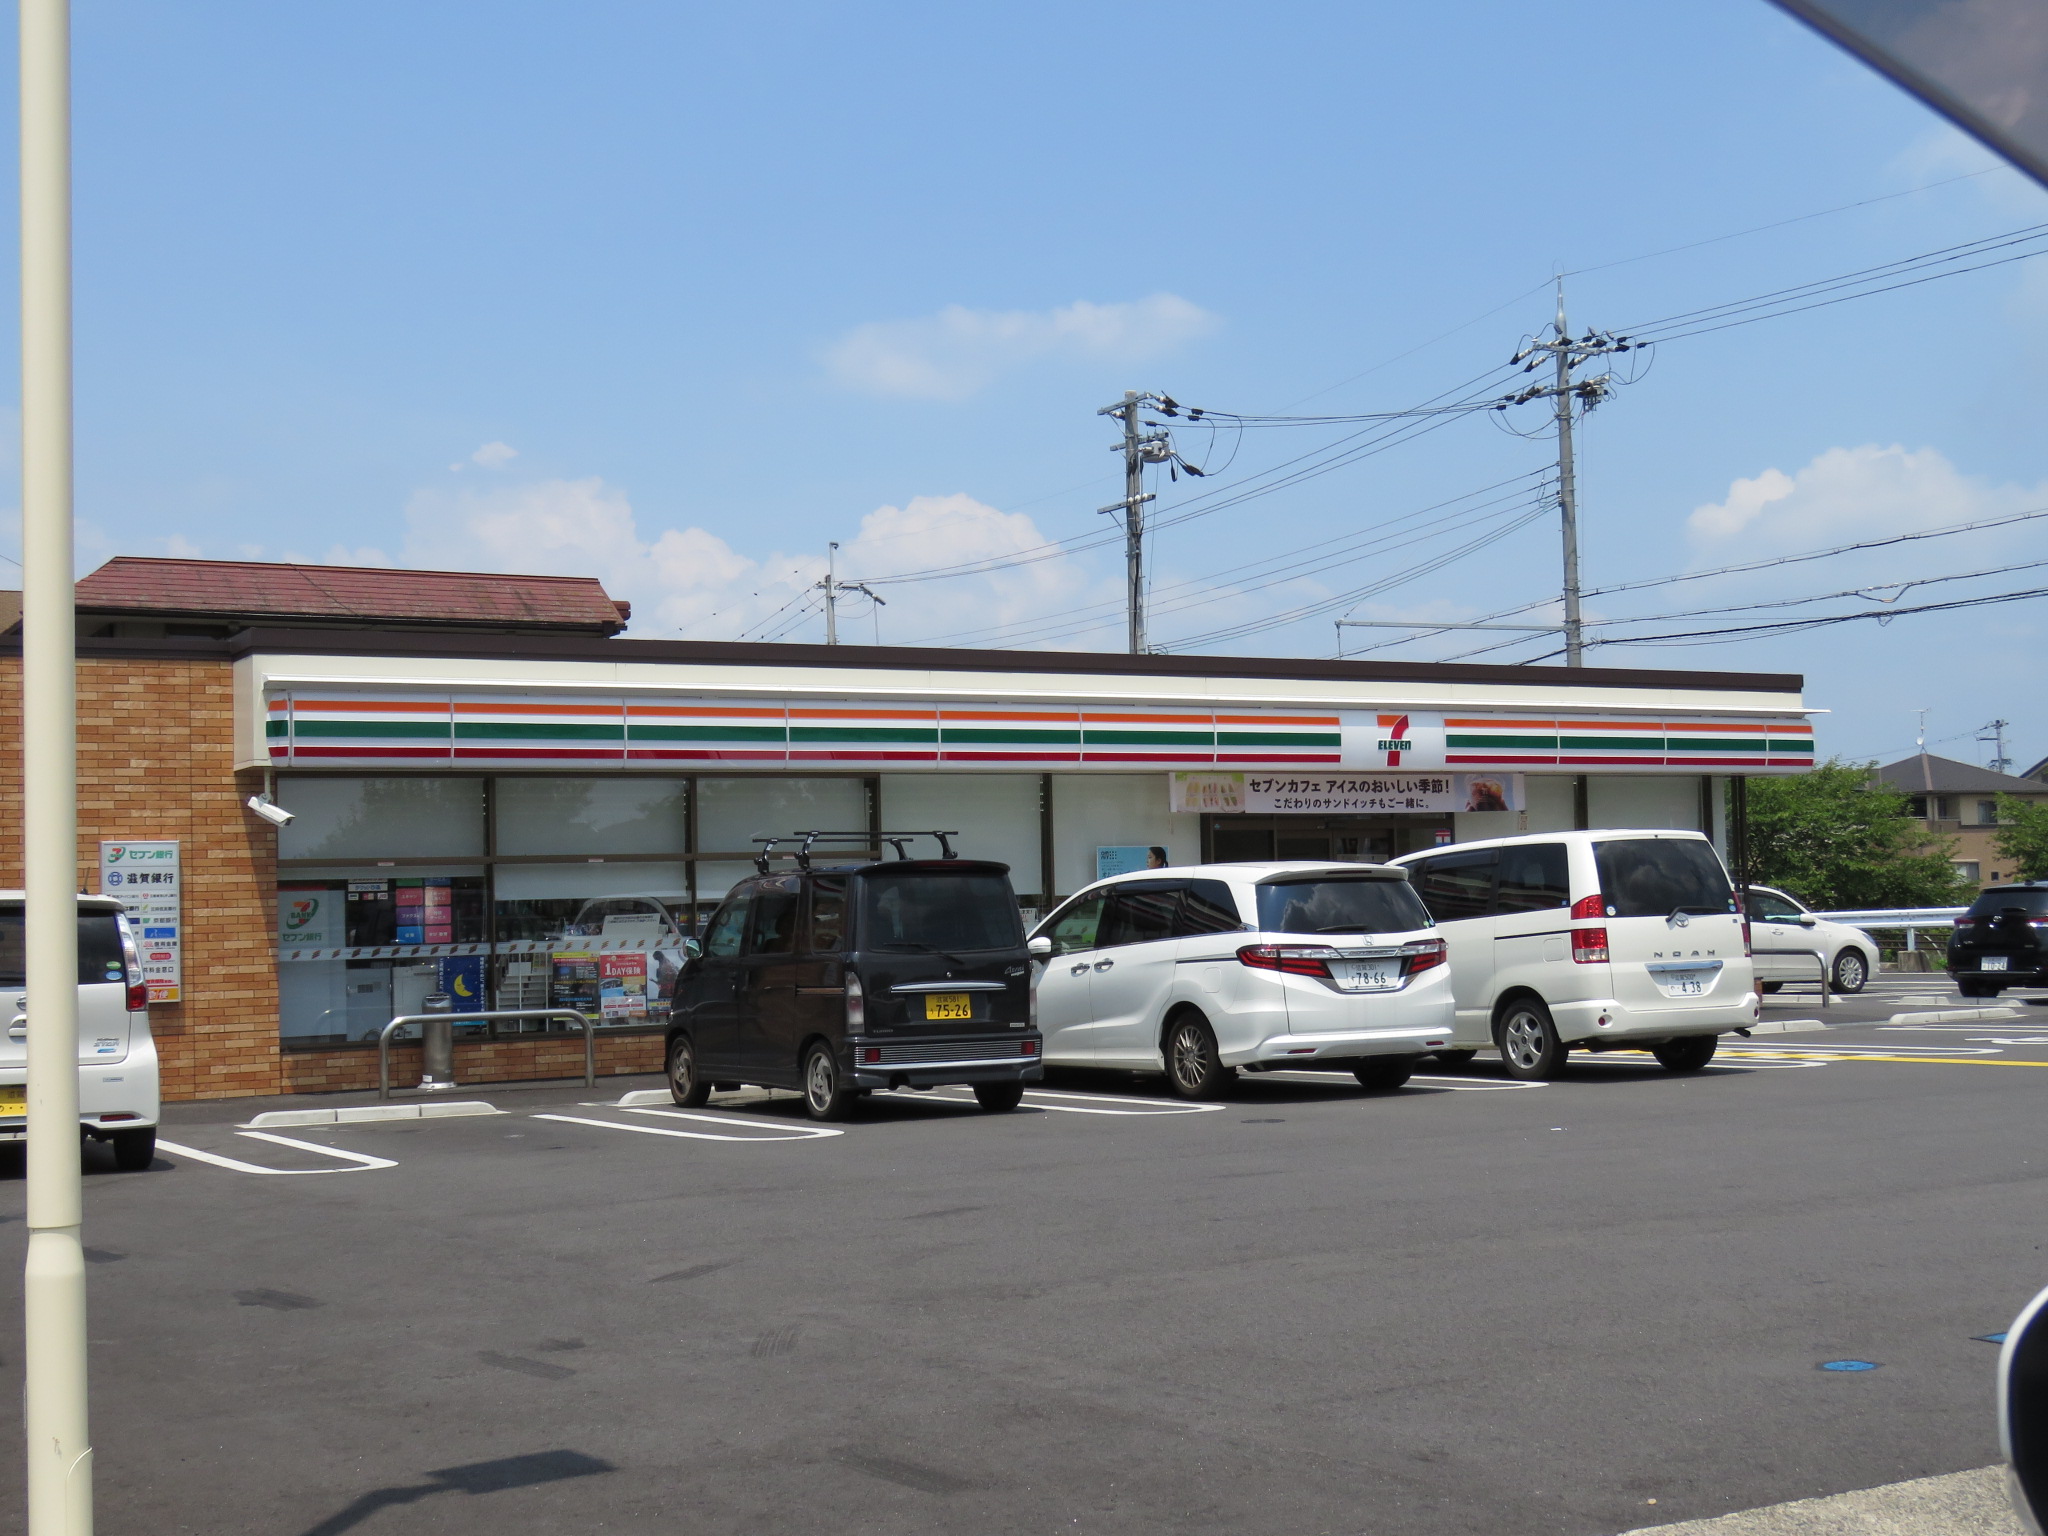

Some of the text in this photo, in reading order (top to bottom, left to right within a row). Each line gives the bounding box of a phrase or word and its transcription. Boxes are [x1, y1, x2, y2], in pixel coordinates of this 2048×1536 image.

[1249, 779, 1321, 794] セブンカフェ
[129, 850, 173, 860] セブン銀行
[127, 873, 174, 885] 滋賀銀行
[282, 933, 322, 942] セブン銀行
[1653, 950, 1716, 958] NOAH
[936, 1004, 969, 1018] 75-26
